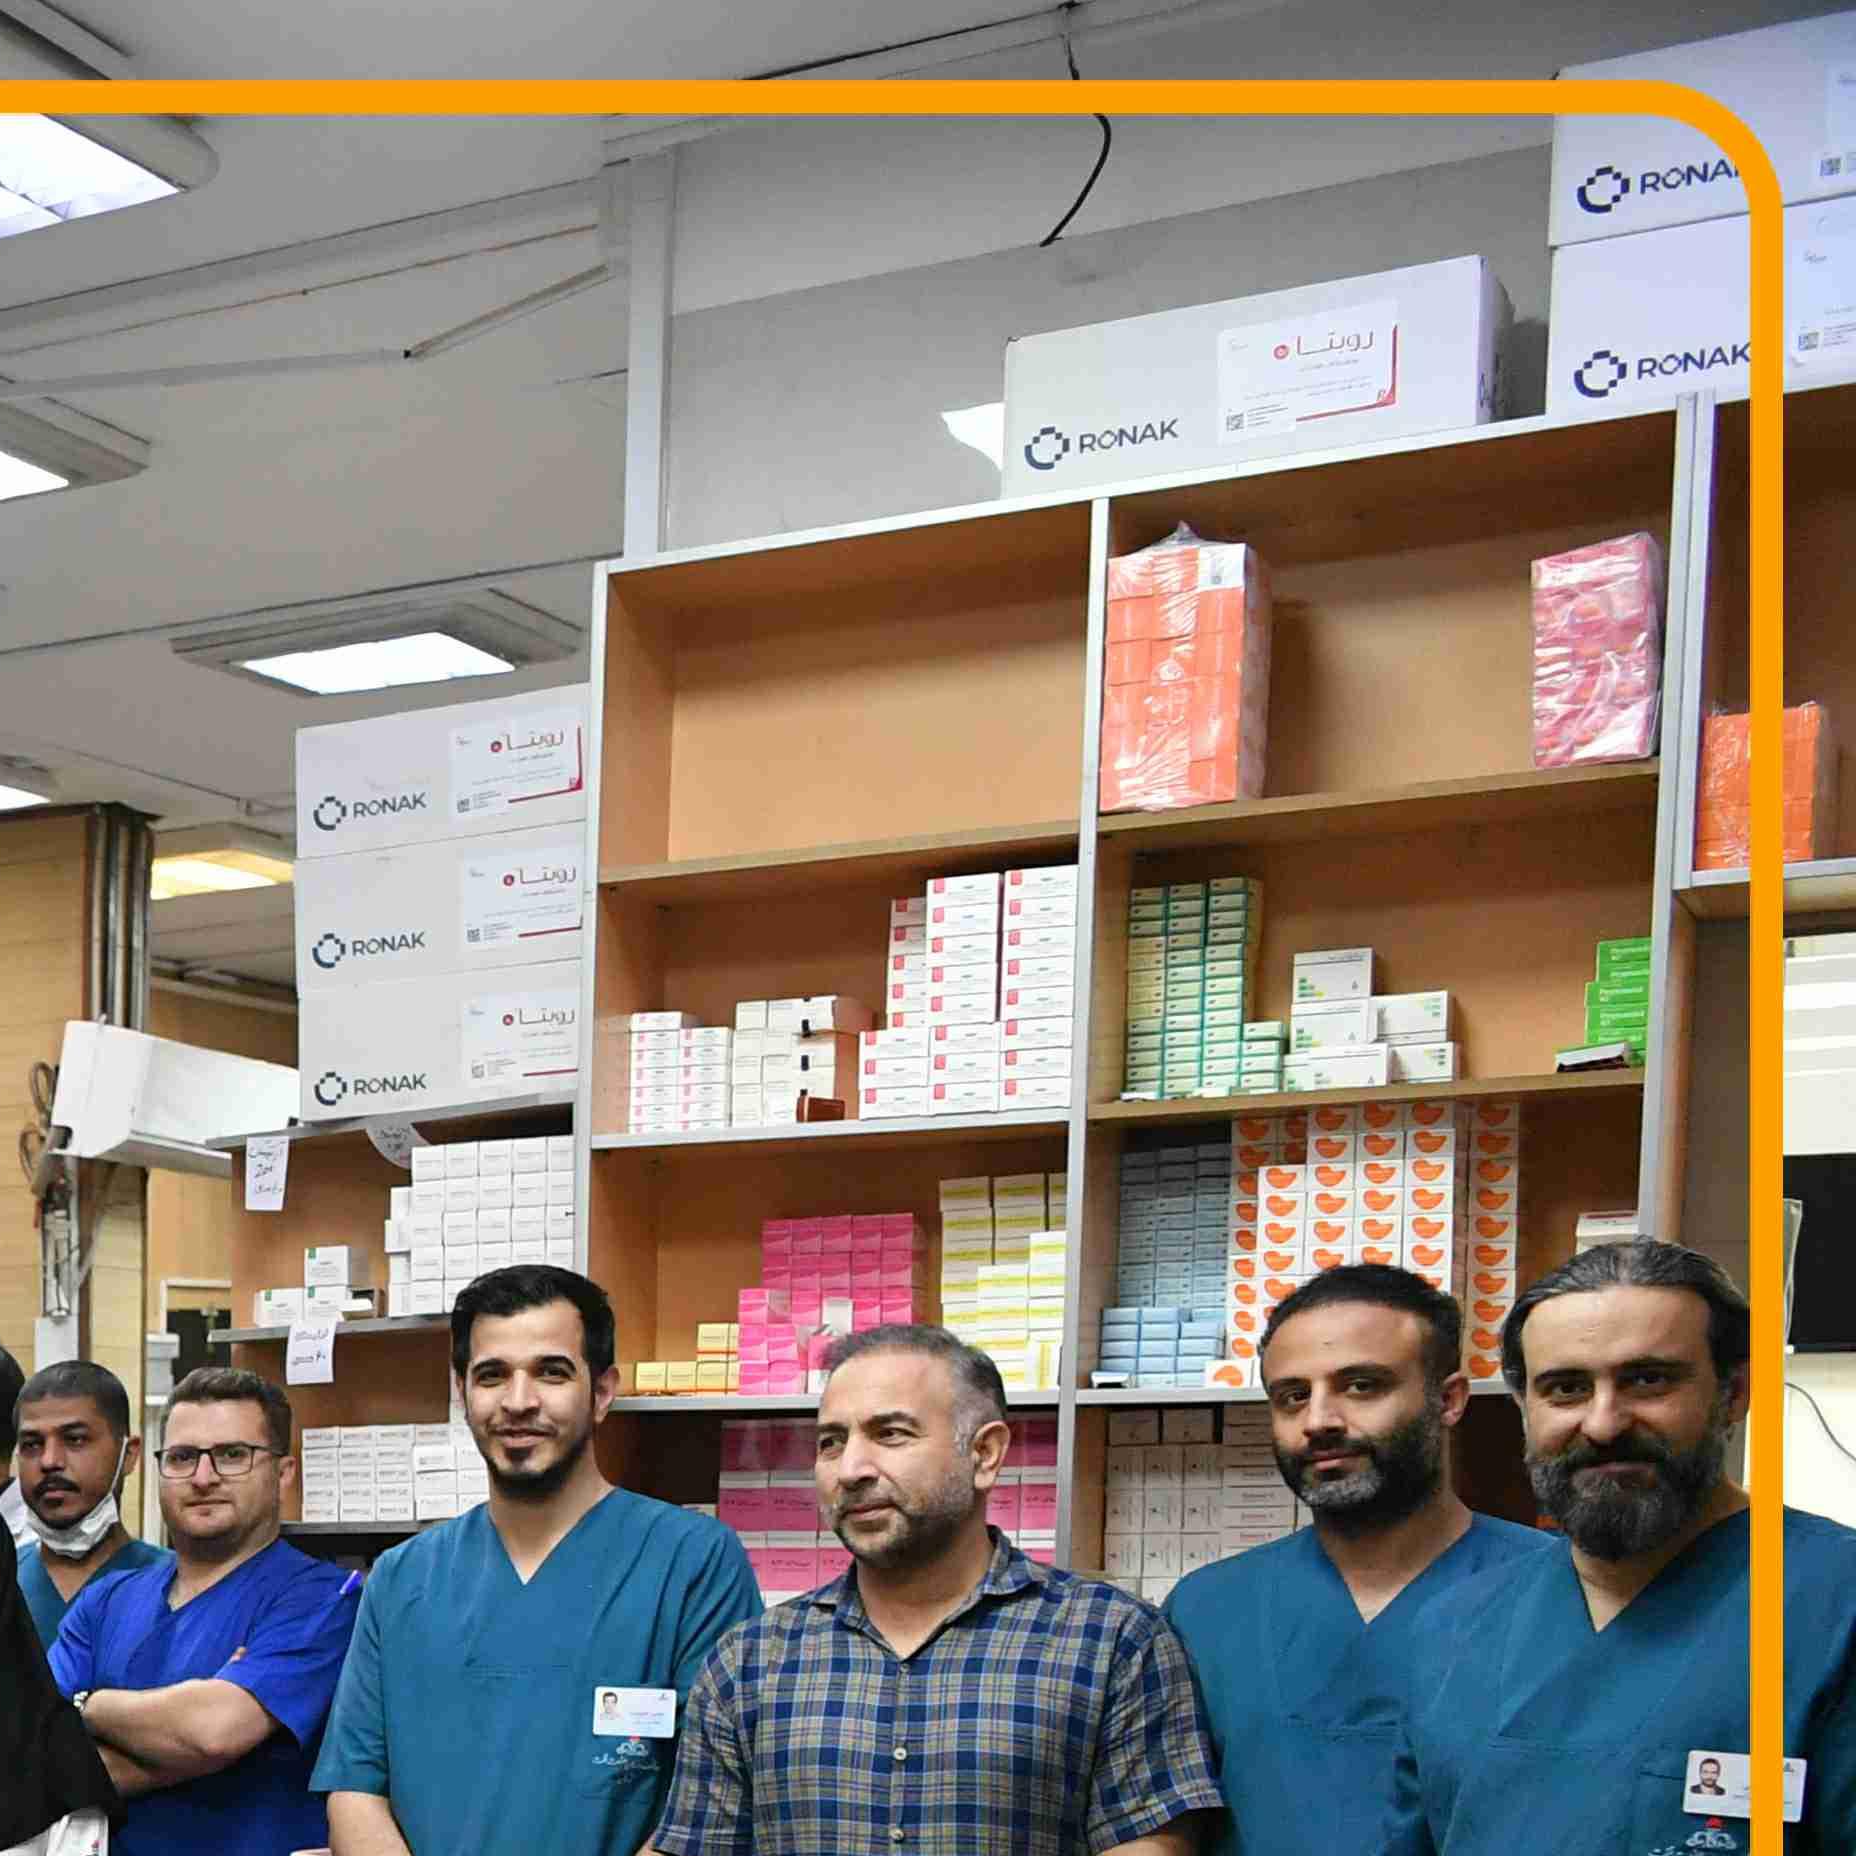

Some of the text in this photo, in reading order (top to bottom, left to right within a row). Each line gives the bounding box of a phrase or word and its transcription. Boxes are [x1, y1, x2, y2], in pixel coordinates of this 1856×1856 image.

[1640, 158, 1739, 195] RONA
[1638, 341, 1751, 380] RONAK
[1079, 418, 1179, 455] RONAK
[353, 791, 427, 819] RONAK
[352, 931, 426, 957] RONAK
[353, 1073, 427, 1096] RONAK
